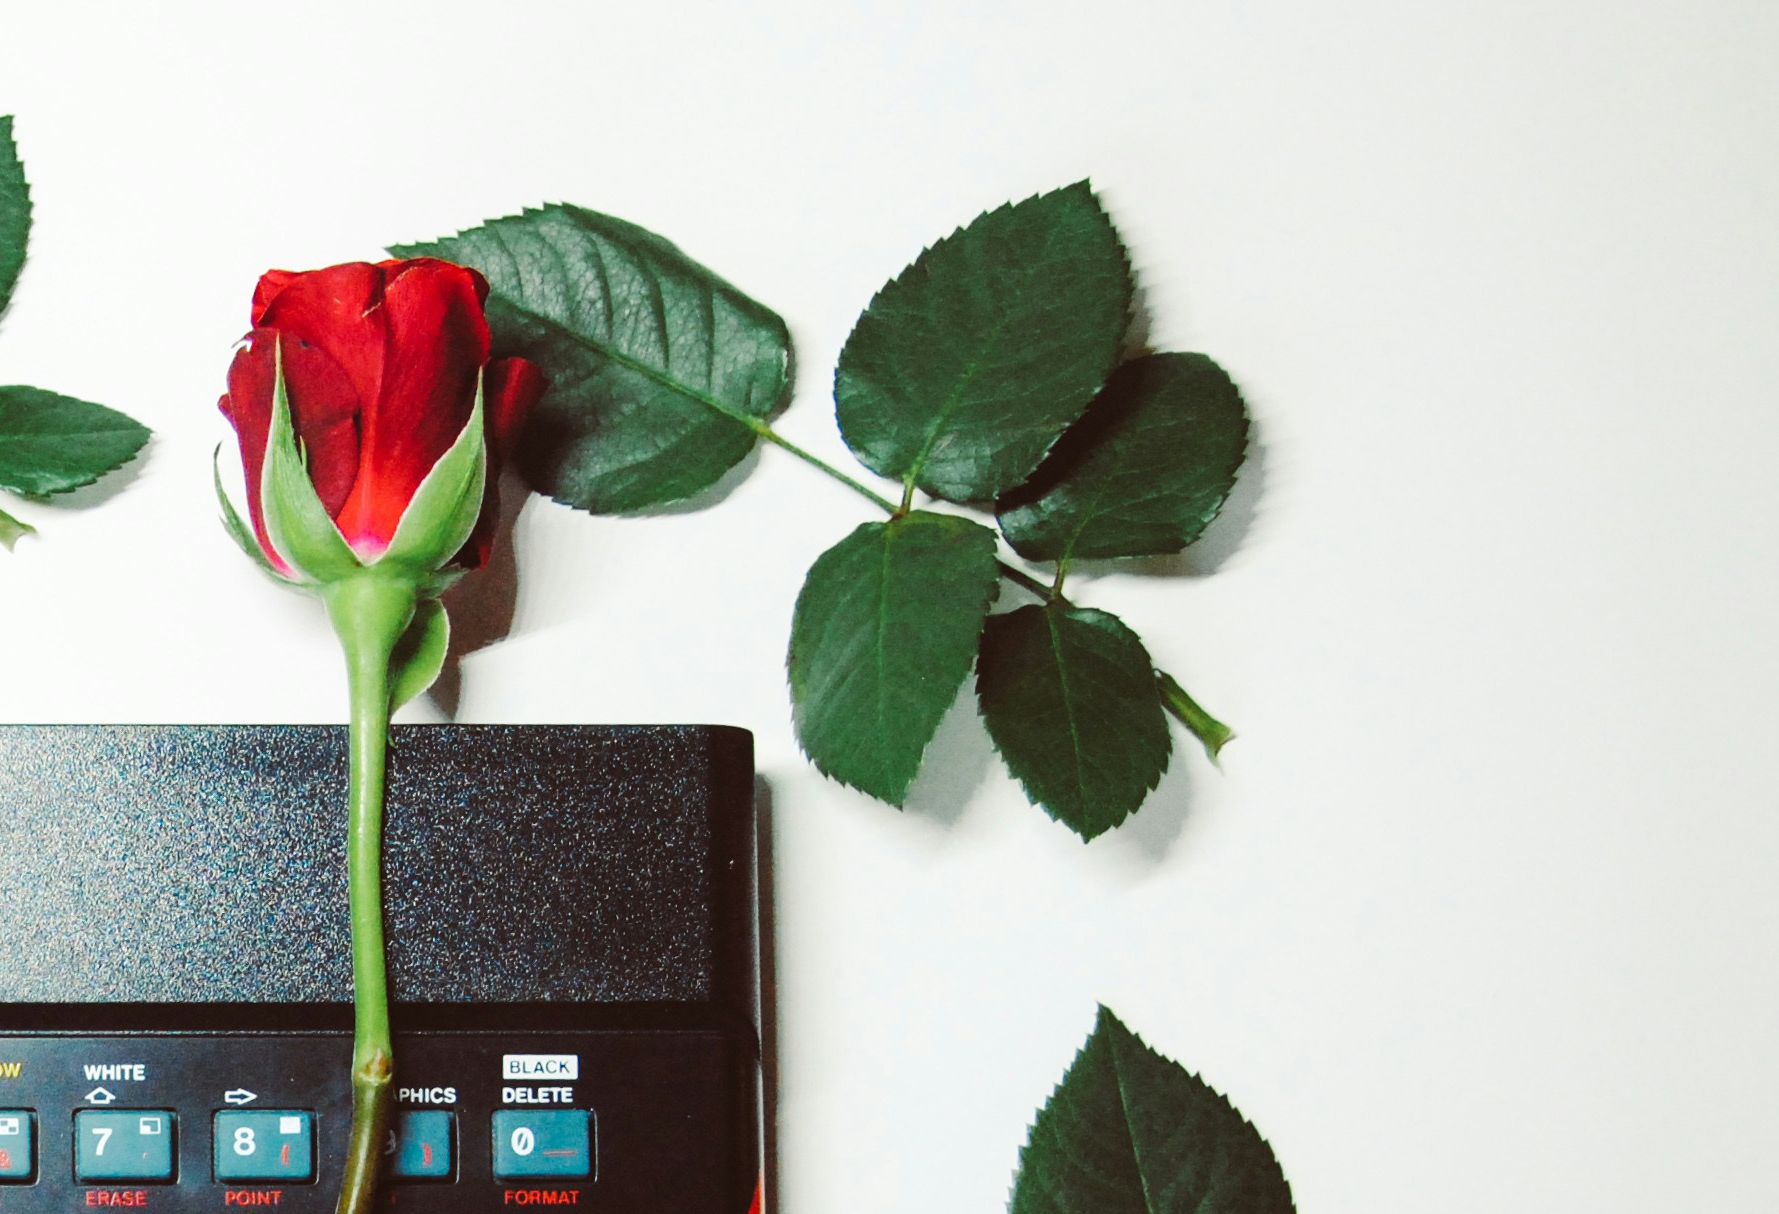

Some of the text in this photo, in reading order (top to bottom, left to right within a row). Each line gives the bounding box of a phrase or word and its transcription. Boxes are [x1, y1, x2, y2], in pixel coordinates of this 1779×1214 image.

[84, 1064, 145, 1081] WHITE
[509, 1061, 570, 1074] BLACK
[399, 1087, 457, 1103] PHICS
[502, 1087, 573, 1103] DELETE
[92, 1128, 113, 1156] 7
[233, 1128, 256, 1156] 8
[511, 1127, 534, 1156] 0
[86, 1191, 147, 1206] ERASE
[225, 1191, 281, 1205] POINT
[505, 1191, 579, 1205] FORMAT
